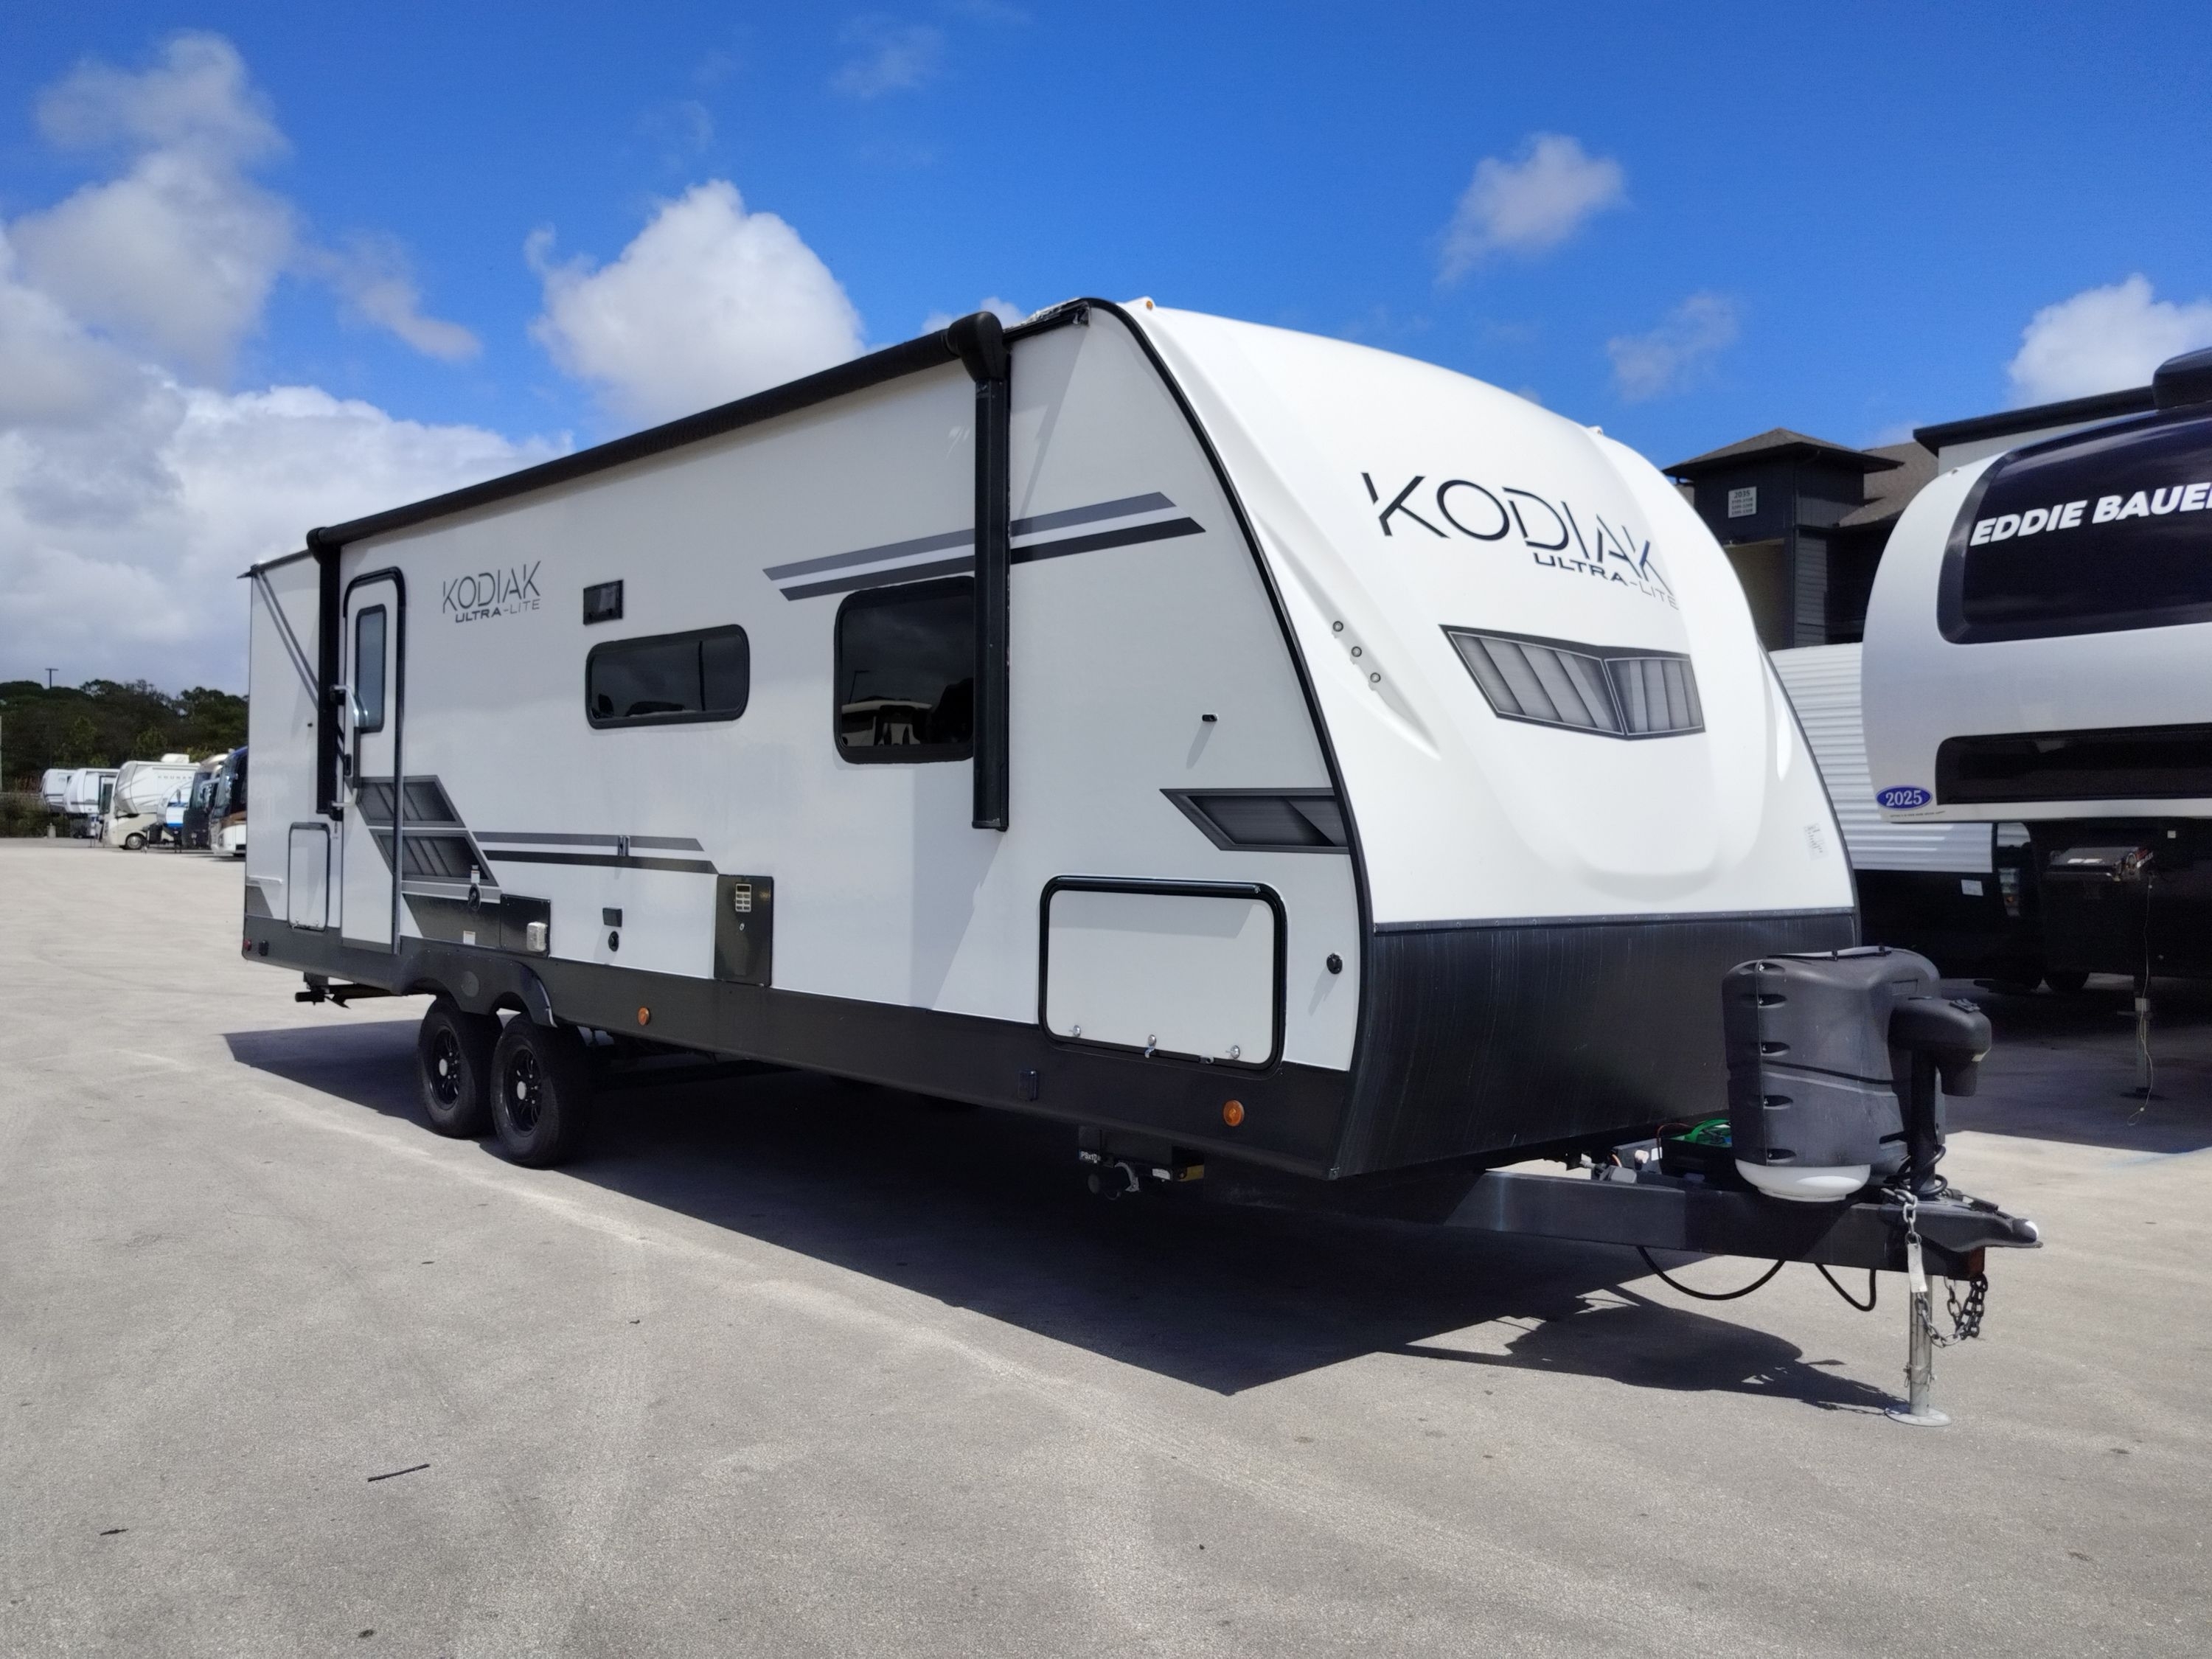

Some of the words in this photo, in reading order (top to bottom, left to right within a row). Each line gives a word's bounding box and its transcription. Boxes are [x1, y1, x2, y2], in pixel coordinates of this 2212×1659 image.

[1361, 473, 1674, 596] KODIAK
[1969, 500, 2088, 546] EDDIE
[2092, 482, 2212, 524] BAUE
[442, 560, 541, 614] KODIAK
[1533, 552, 1680, 611] ULTRA-LITE
[455, 599, 540, 623] ULTRA-LITE
[1885, 790, 1923, 807] 2025
